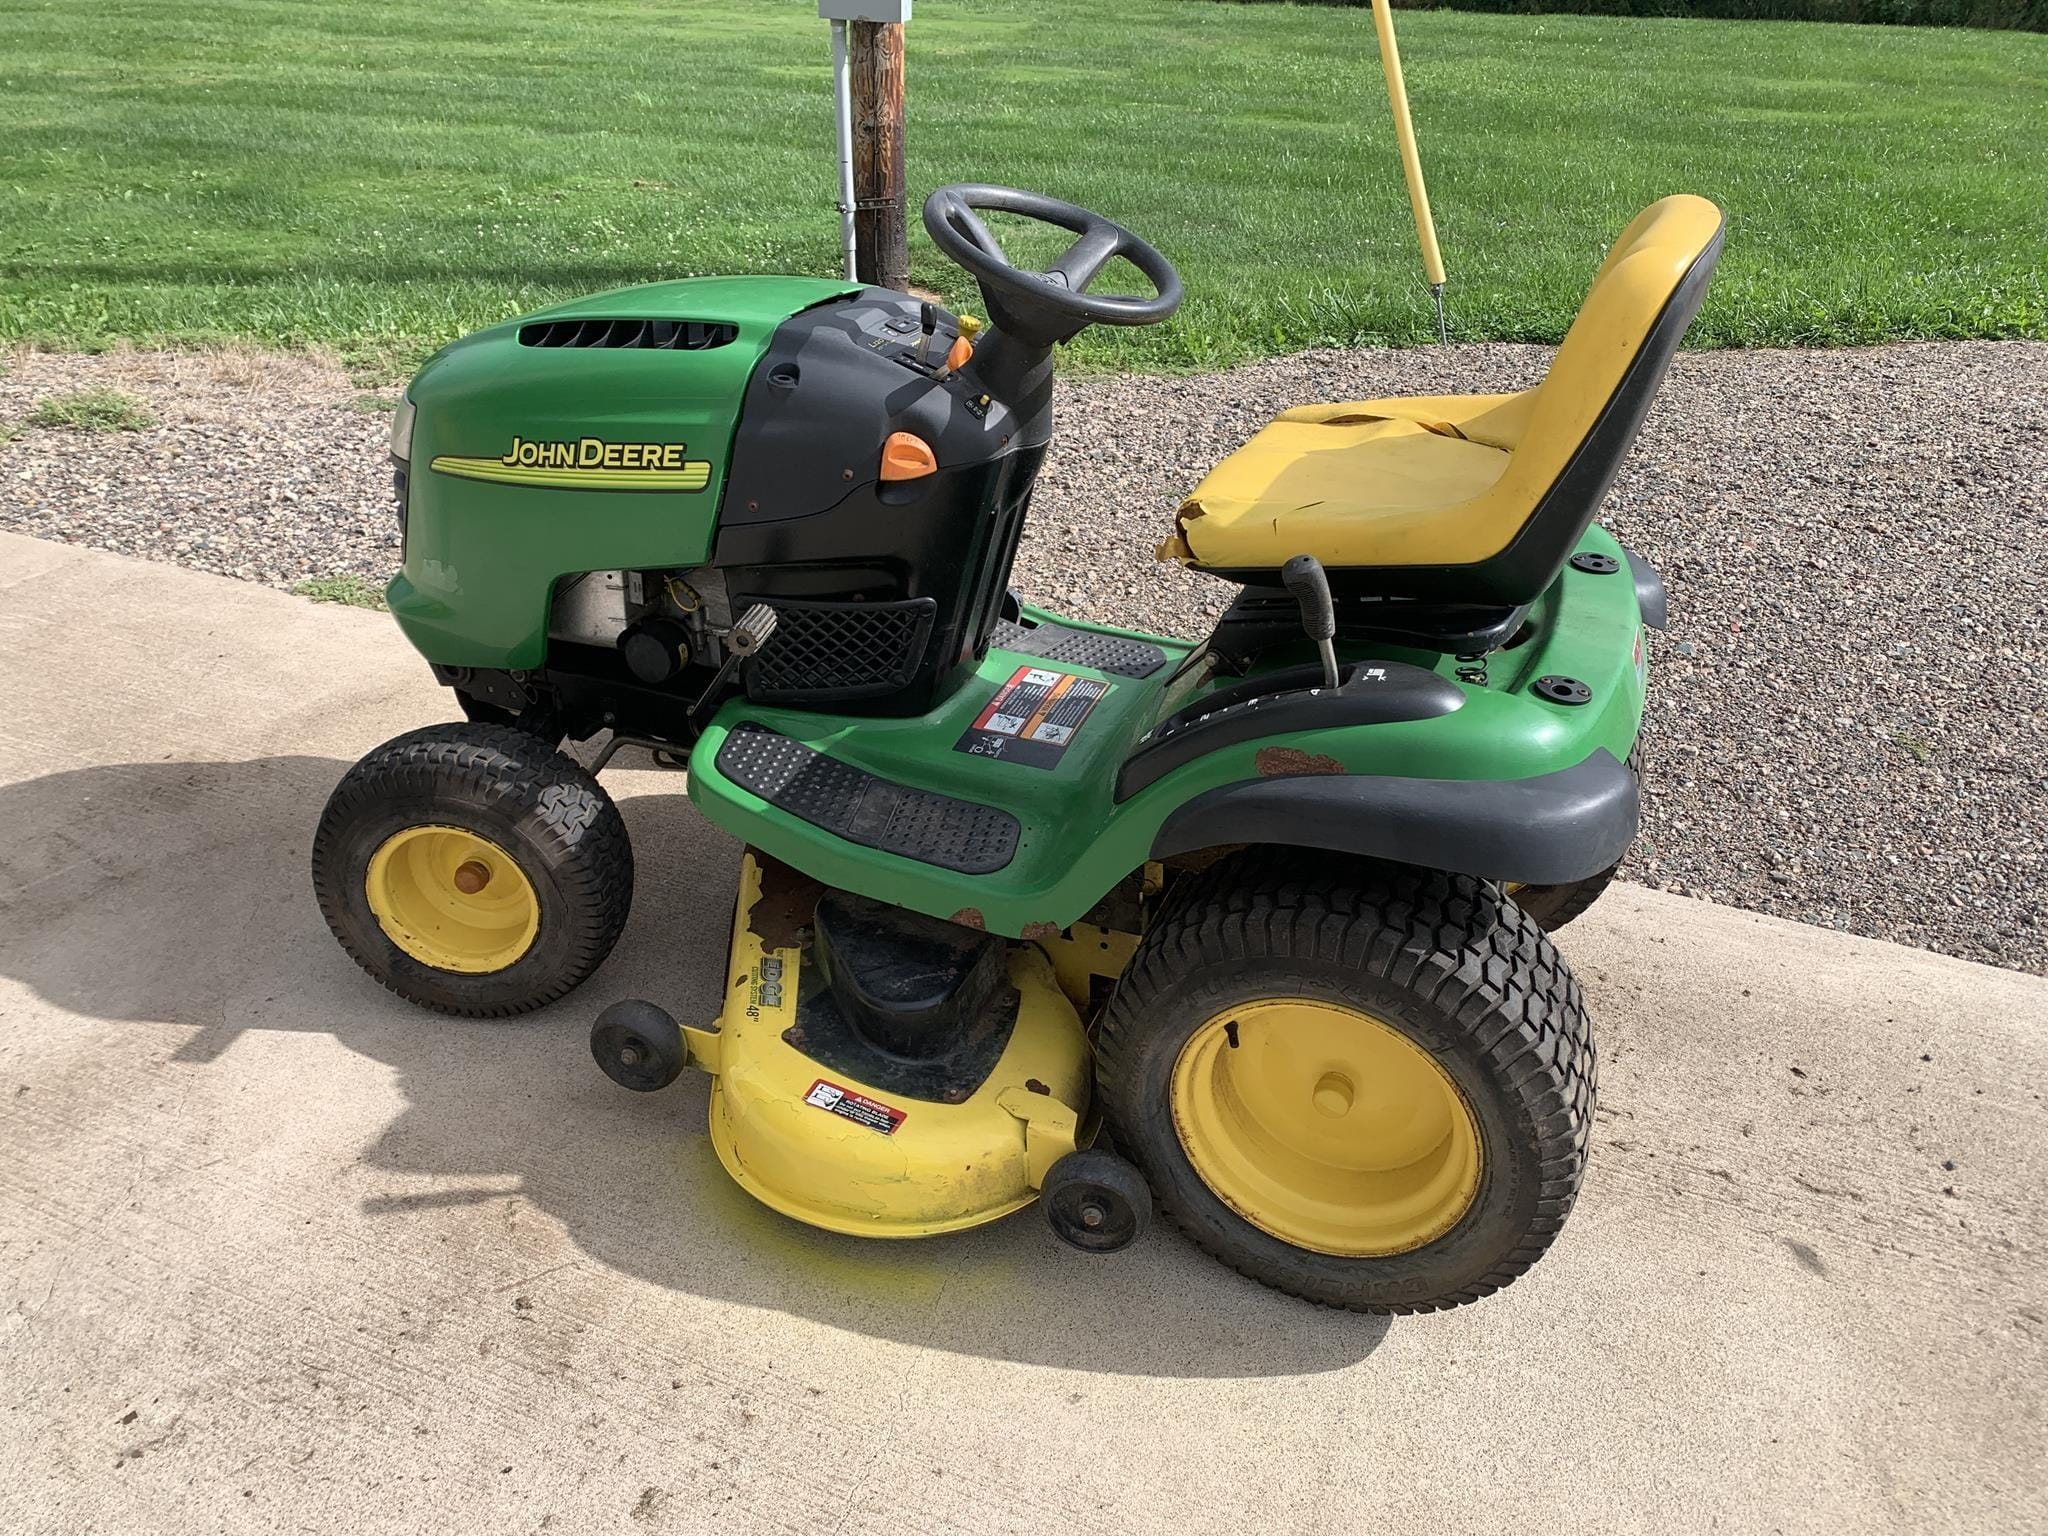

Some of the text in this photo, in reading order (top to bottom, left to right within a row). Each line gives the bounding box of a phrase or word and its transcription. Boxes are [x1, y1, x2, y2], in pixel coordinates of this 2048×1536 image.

[503, 437, 685, 470] JOHN DEERE
[760, 957, 783, 1008] EDGE
[862, 1099, 891, 1114] DANGER
